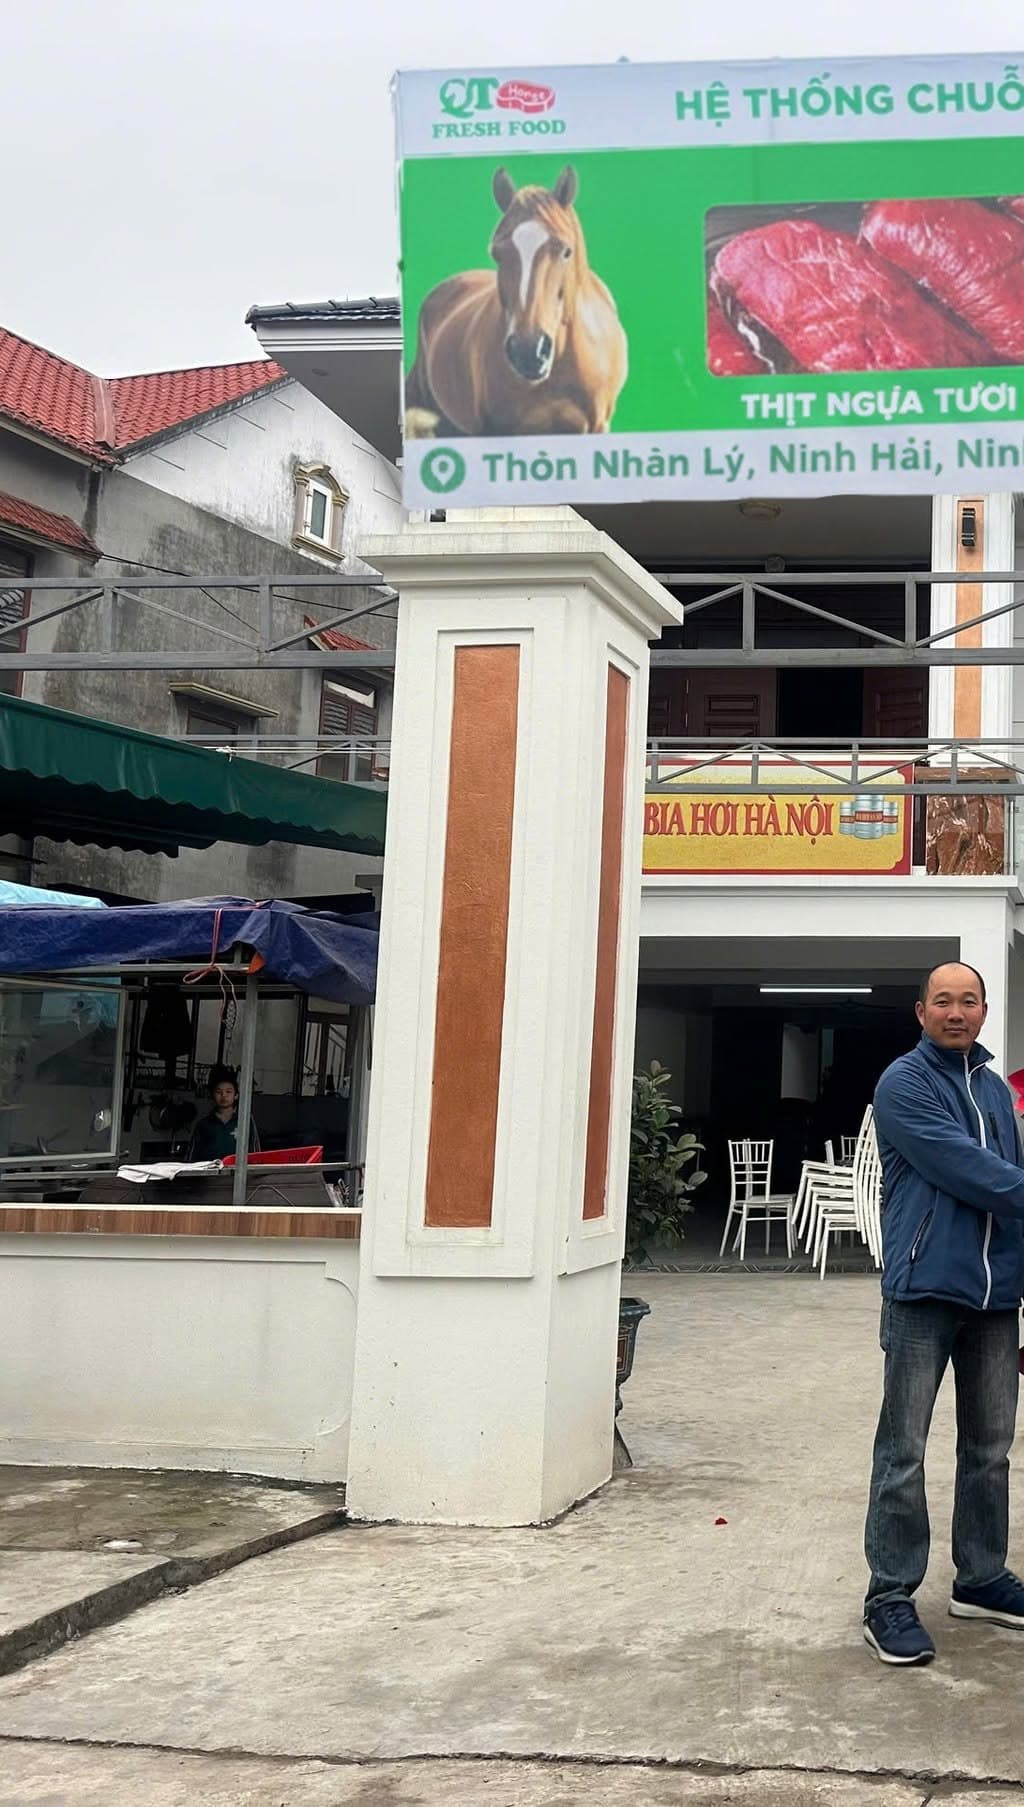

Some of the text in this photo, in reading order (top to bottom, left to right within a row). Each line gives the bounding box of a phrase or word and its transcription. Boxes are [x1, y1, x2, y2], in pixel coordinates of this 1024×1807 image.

[440, 77, 499, 118] QT
[675, 80, 731, 127] HỆ
[743, 72, 894, 119] THỐNG
[432, 120, 566, 138] FRESH FOOD
[741, 381, 1017, 427] THỊT NGỰA TƯƠI
[704, 444, 755, 482] Lý,
[769, 441, 856, 473] Ninh
[643, 793, 834, 845] BIA HƠI HÀ NỘI
